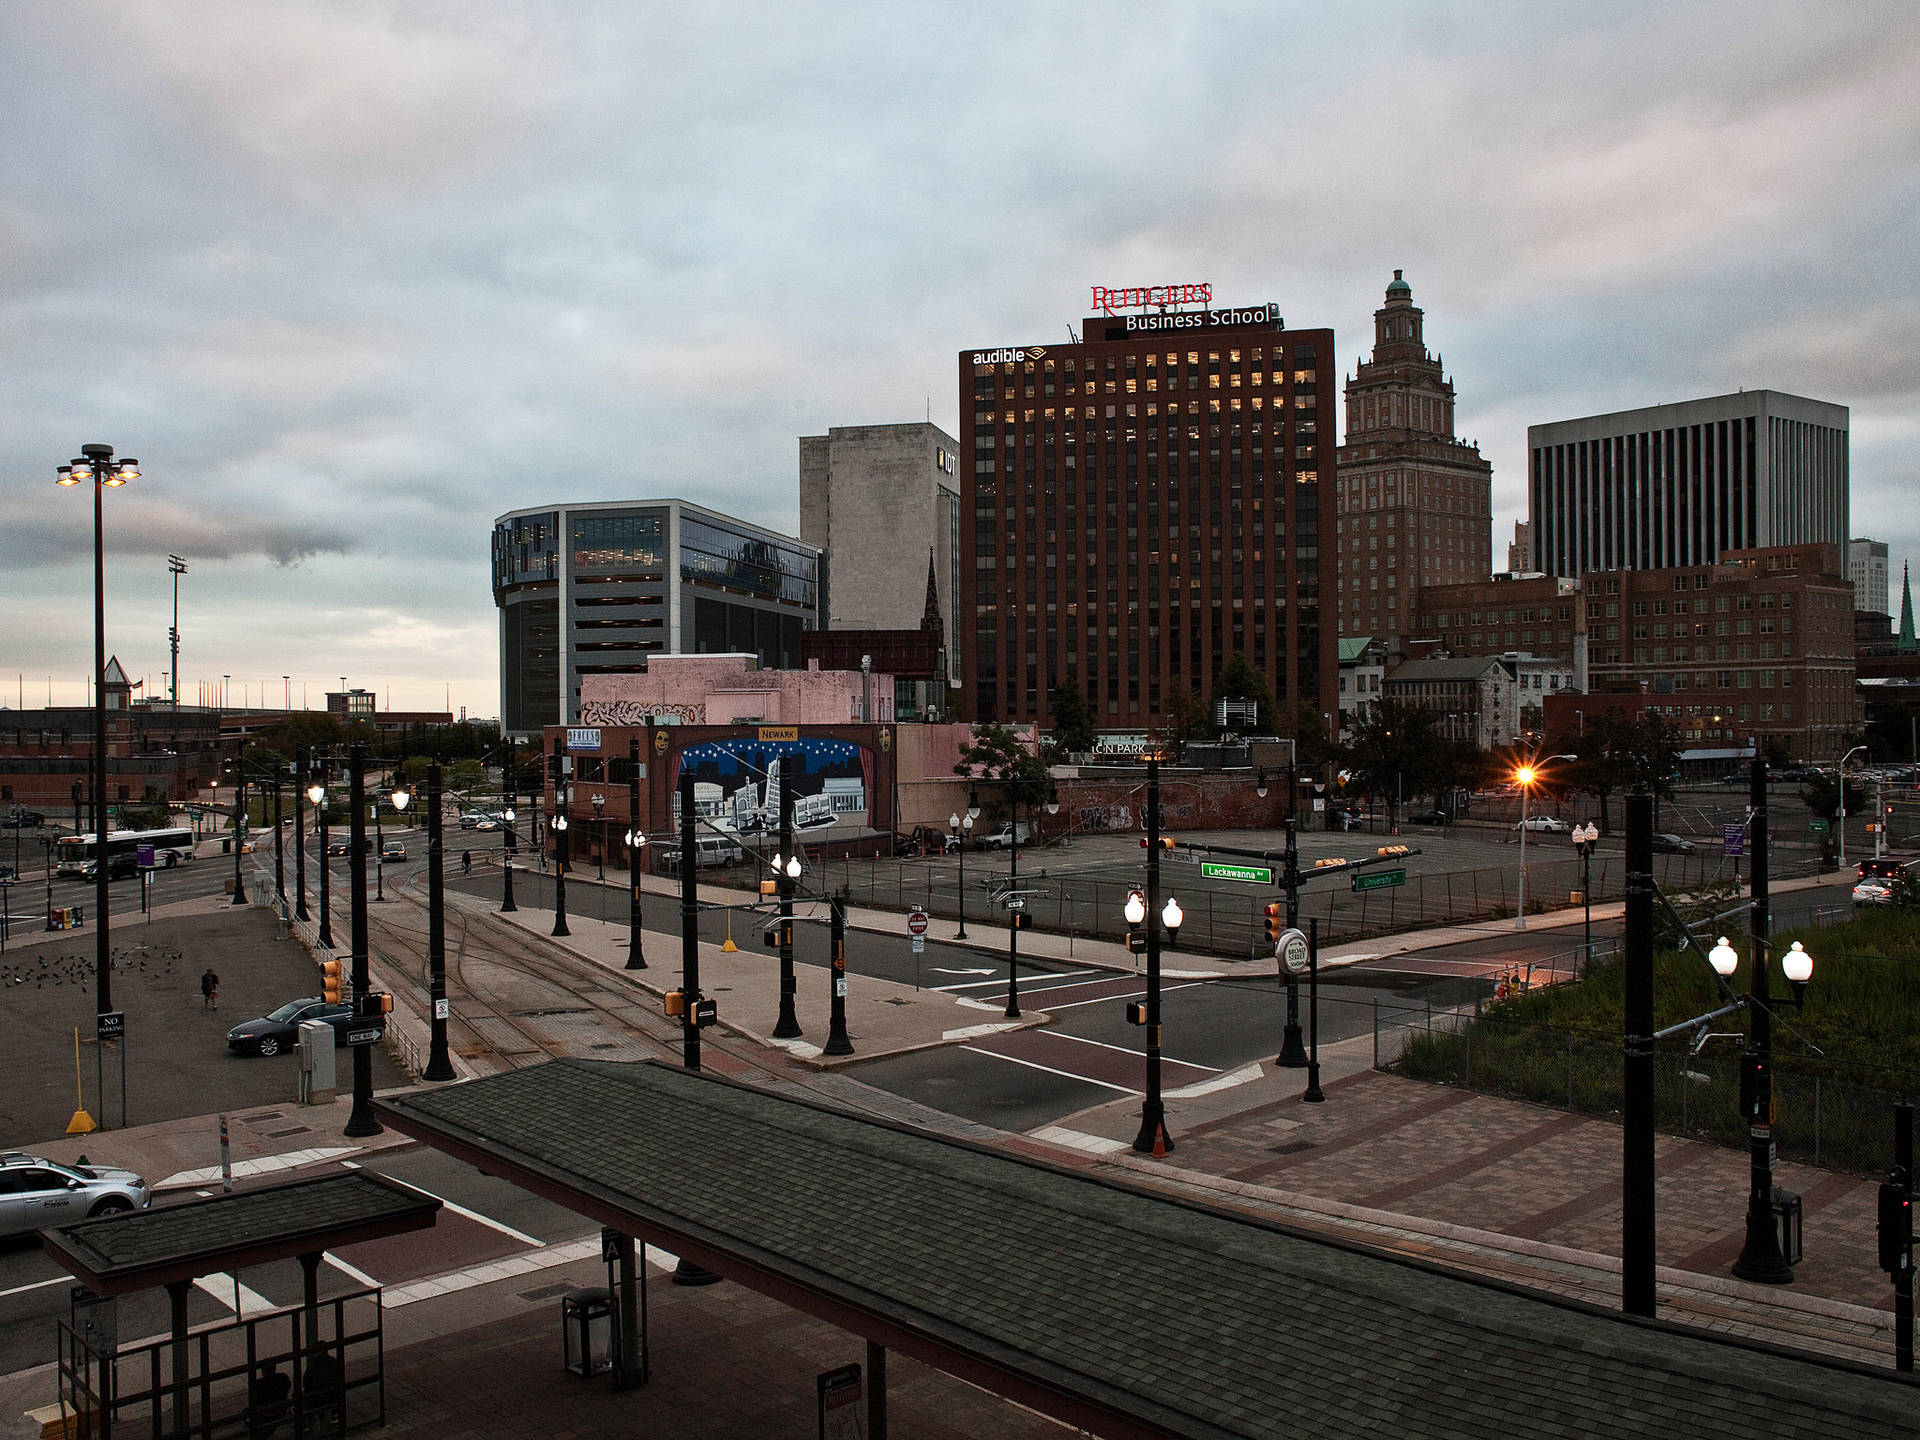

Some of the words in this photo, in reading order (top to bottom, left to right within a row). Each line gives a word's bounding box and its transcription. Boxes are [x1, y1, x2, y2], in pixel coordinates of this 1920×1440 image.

[1091, 283, 1212, 316] RUTGERS
[1126, 313, 1202, 331] Business
[1210, 306, 1270, 326] School
[973, 349, 1025, 364] audible
[945, 451, 955, 475] IDT
[762, 730, 794, 738] NEWARK
[1117, 744, 1145, 754] PARK
[1209, 867, 1256, 880] Lackawanna
[1288, 947, 1306, 955] BROAD
[104, 1018, 118, 1026] NO
[607, 1241, 620, 1258] A
